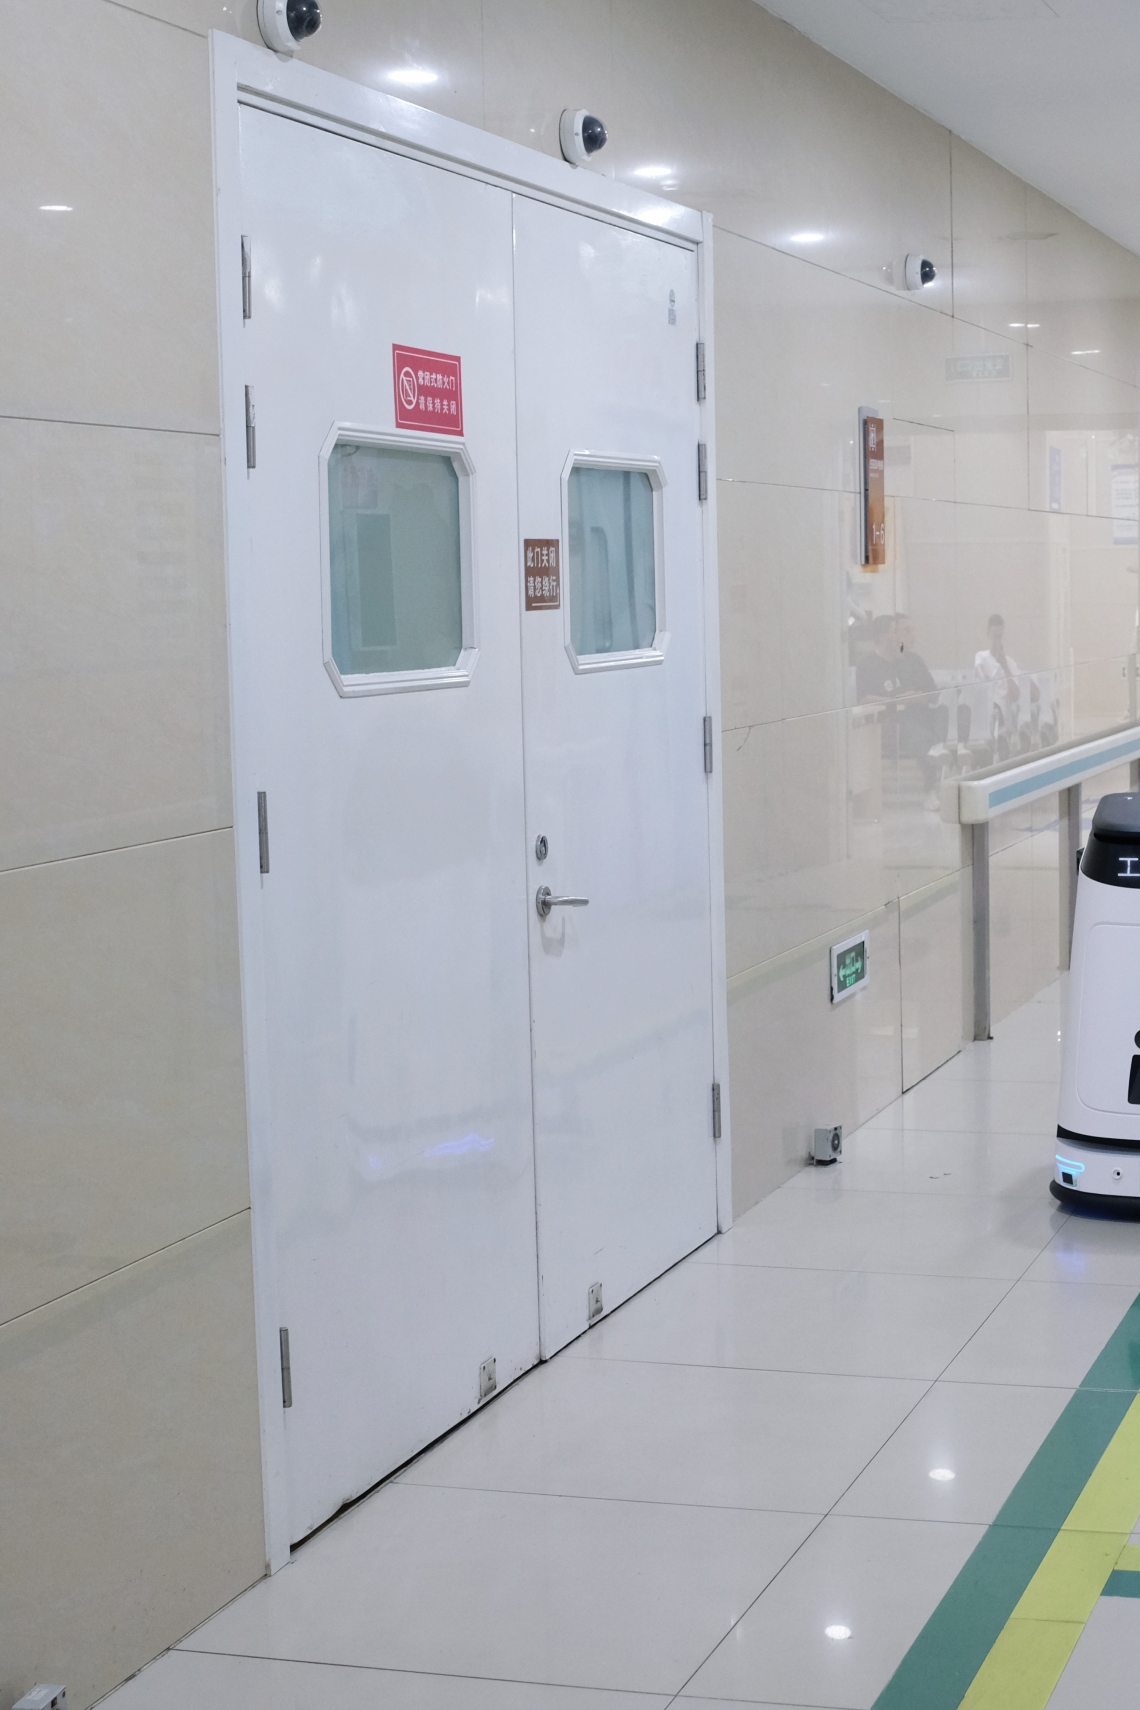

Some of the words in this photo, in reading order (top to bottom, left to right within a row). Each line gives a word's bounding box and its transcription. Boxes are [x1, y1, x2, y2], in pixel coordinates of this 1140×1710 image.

[417, 370, 456, 391] 常闭式防火门
[418, 396, 457, 415] 请保持关闭
[872, 523, 885, 545] 1-6
[526, 547, 556, 568] 此门关闭
[527, 575, 557, 597] 请您绕行
[846, 973, 856, 987] EXIT
